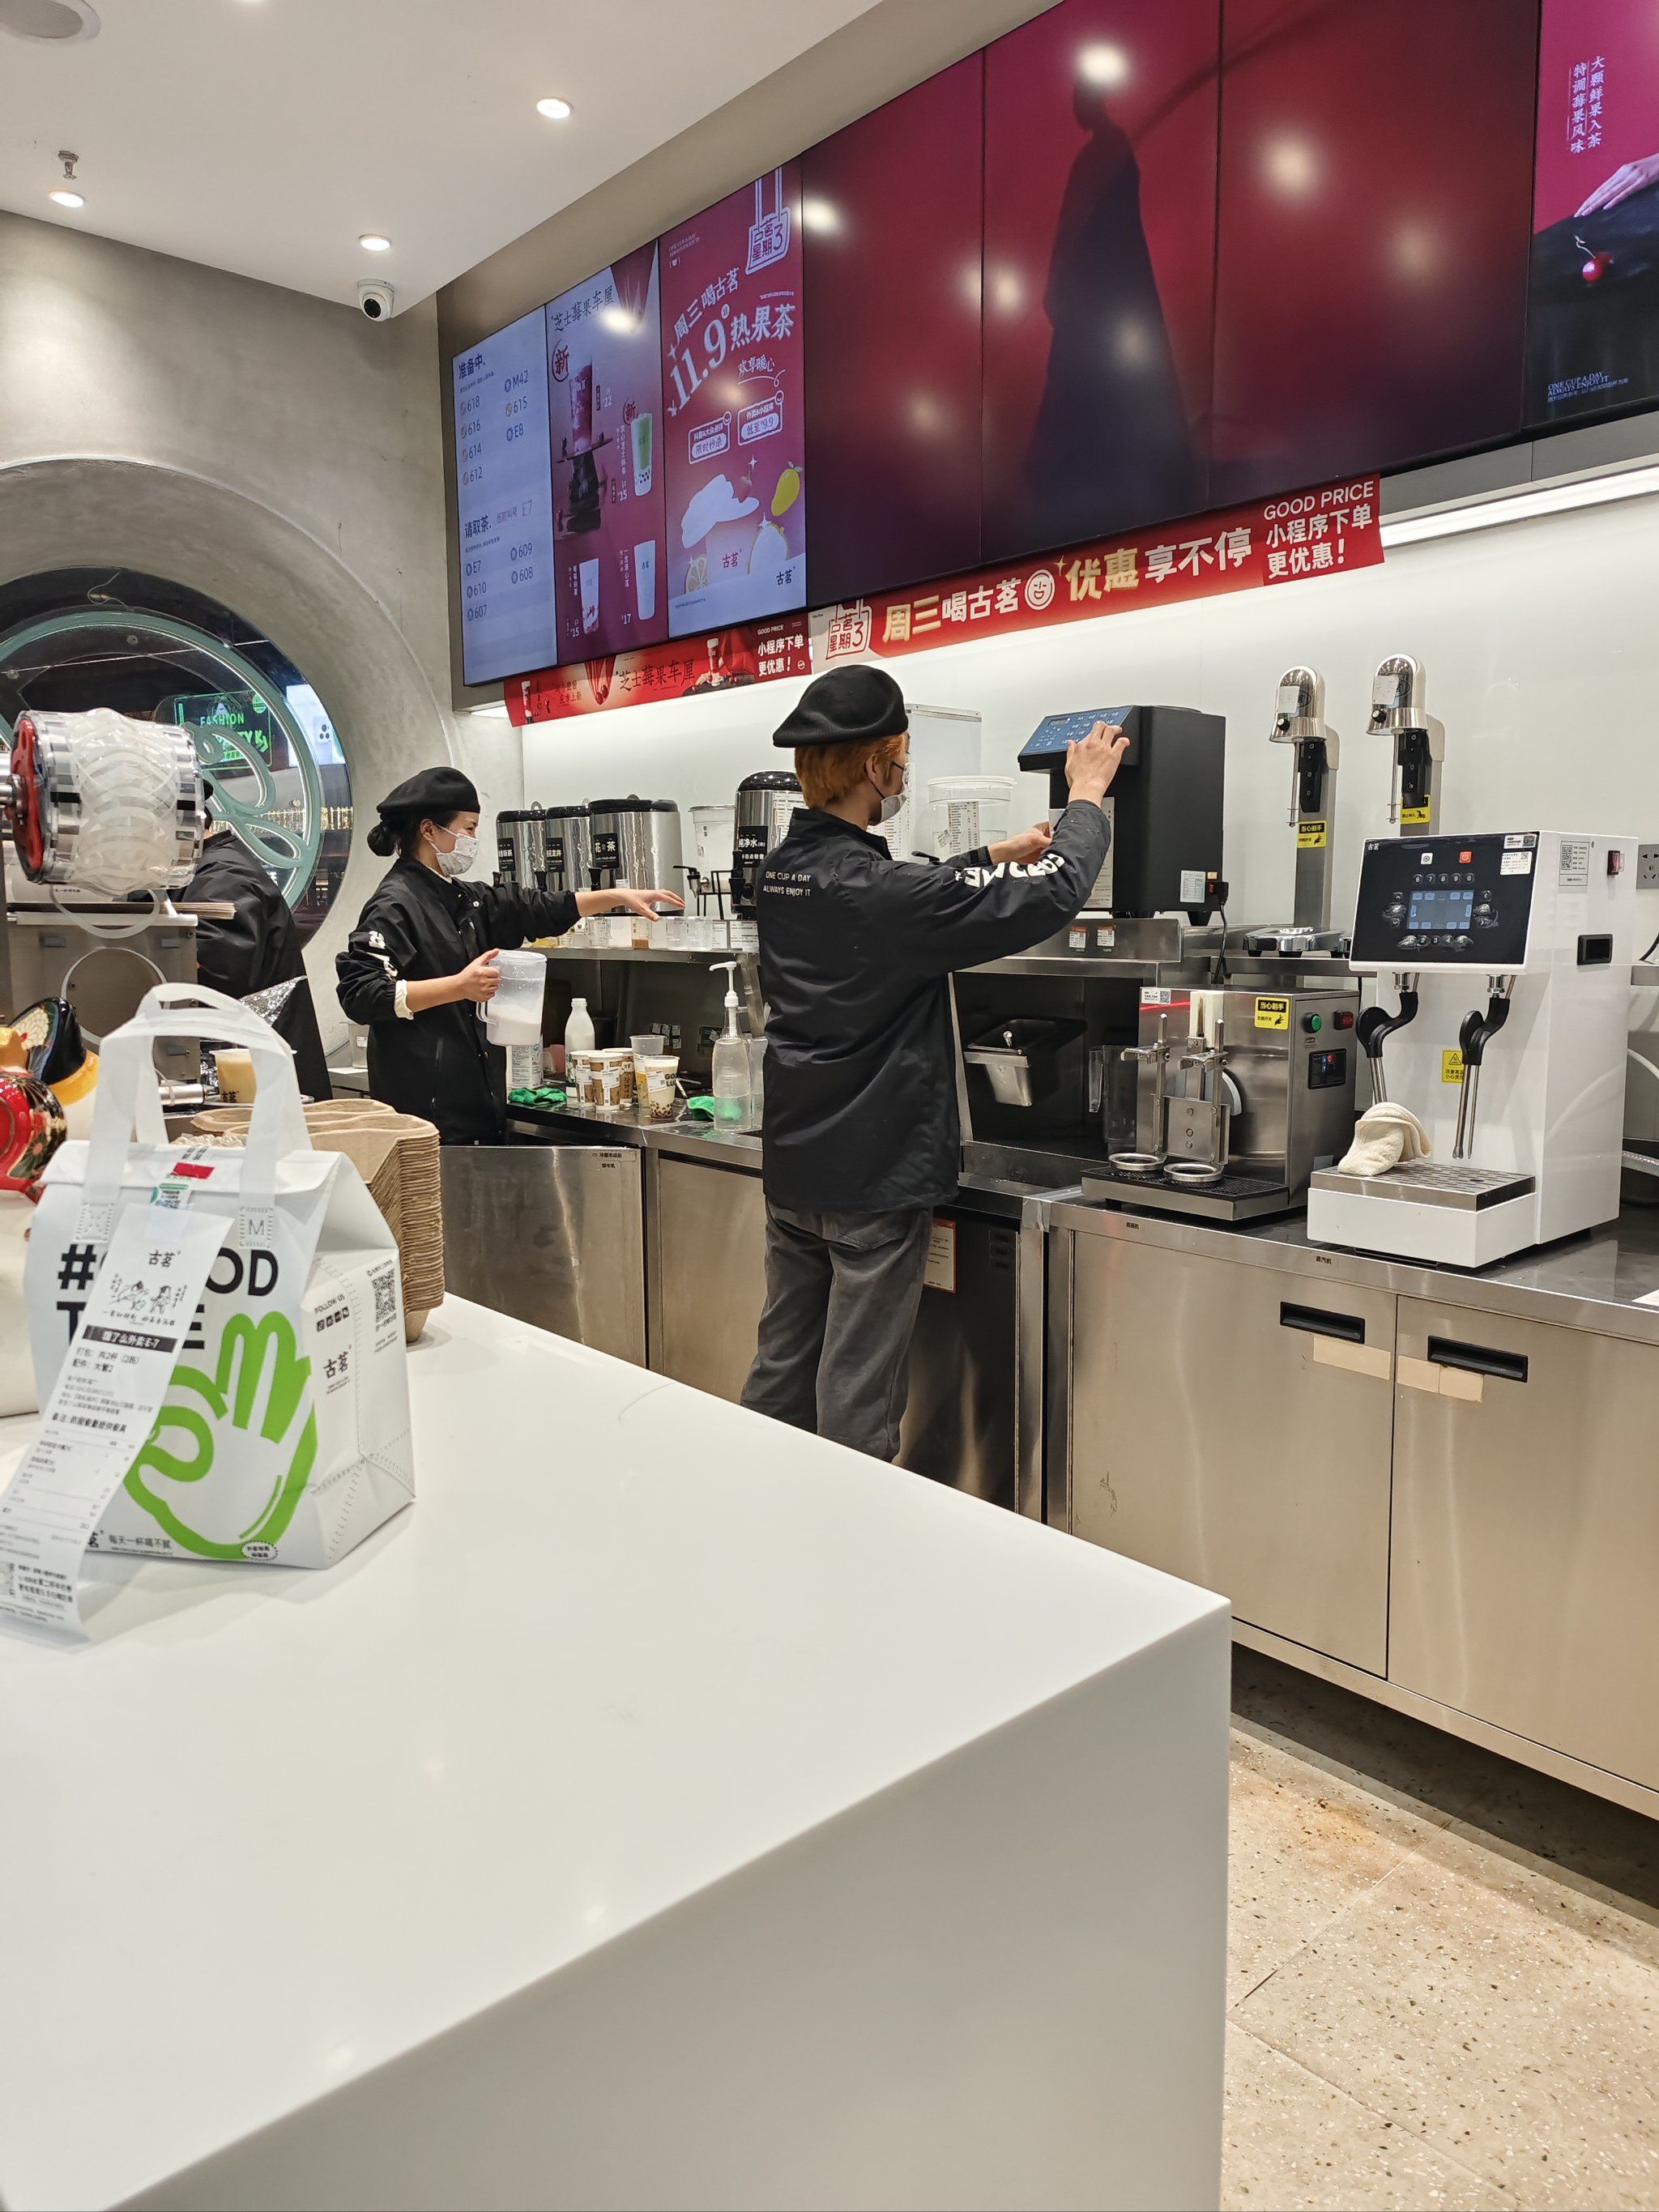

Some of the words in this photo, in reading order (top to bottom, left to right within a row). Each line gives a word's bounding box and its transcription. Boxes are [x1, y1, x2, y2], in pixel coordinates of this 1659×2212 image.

[674, 267, 740, 344] 周三喝古茗
[731, 304, 796, 351] 热果茶
[555, 344, 569, 375] 新
[671, 319, 726, 410] 11.9
[513, 370, 528, 387] M42
[467, 395, 480, 411] 618
[514, 396, 527, 413] 615
[468, 418, 481, 435] 616
[514, 423, 524, 437] E8
[469, 443, 482, 458] 614
[470, 467, 483, 482] 612
[522, 500, 532, 517] E7
[1264, 497, 1316, 522] GOOD
[1320, 480, 1375, 508] PRICE
[1266, 504, 1373, 550] 小程序下单
[518, 543, 532, 557] 609
[473, 560, 481, 573] E7
[723, 552, 739, 569] 古茗
[519, 567, 533, 582] 608
[776, 569, 793, 586] 古茗
[474, 582, 487, 595] 610
[883, 577, 1021, 644] 周三喝古茗
[1065, 527, 1252, 602] 优惠享不停
[475, 604, 487, 619] 607
[757, 627, 770, 636] GOOD
[770, 624, 784, 633] PRICE
[757, 633, 804, 657] 小程序下单
[766, 871, 776, 880] ONE
[778, 872, 790, 880] CUP
[798, 874, 811, 883] DAY
[763, 884, 785, 894] ALWAYS
[786, 887, 804, 897] ENJOY
[804, 889, 811, 897] IT
[149, 1250, 175, 1268] 古茗
[314, 1298, 338, 1315] FOLLOW
[323, 1351, 348, 1379] 古茗
